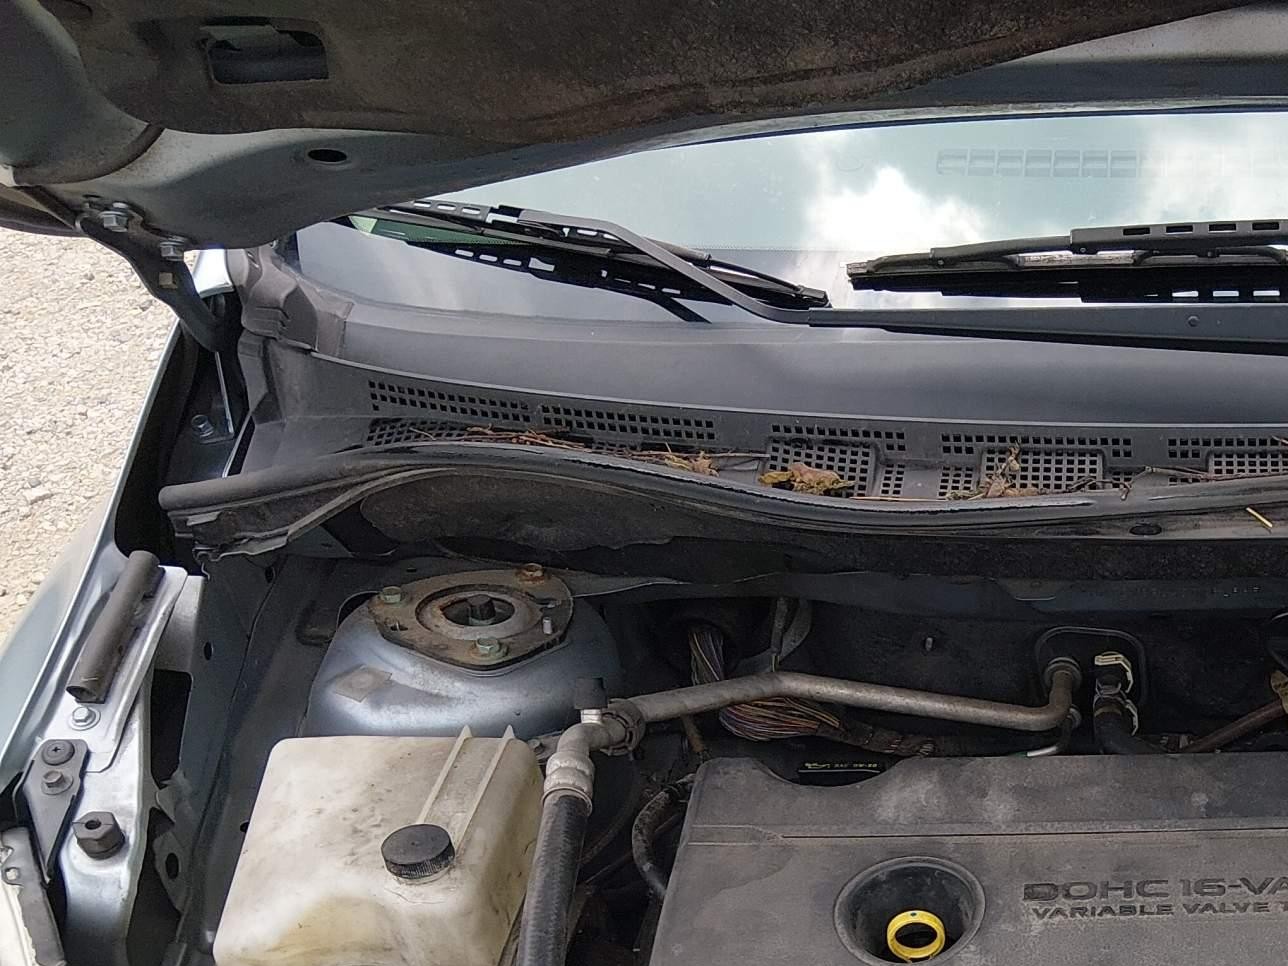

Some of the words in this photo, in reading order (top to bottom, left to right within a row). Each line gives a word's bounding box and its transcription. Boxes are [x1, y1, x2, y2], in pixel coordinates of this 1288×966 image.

[1022, 879, 1169, 901] DOHC
[1032, 903, 1175, 920] VARIABLE
[1182, 901, 1271, 916] VALVE
